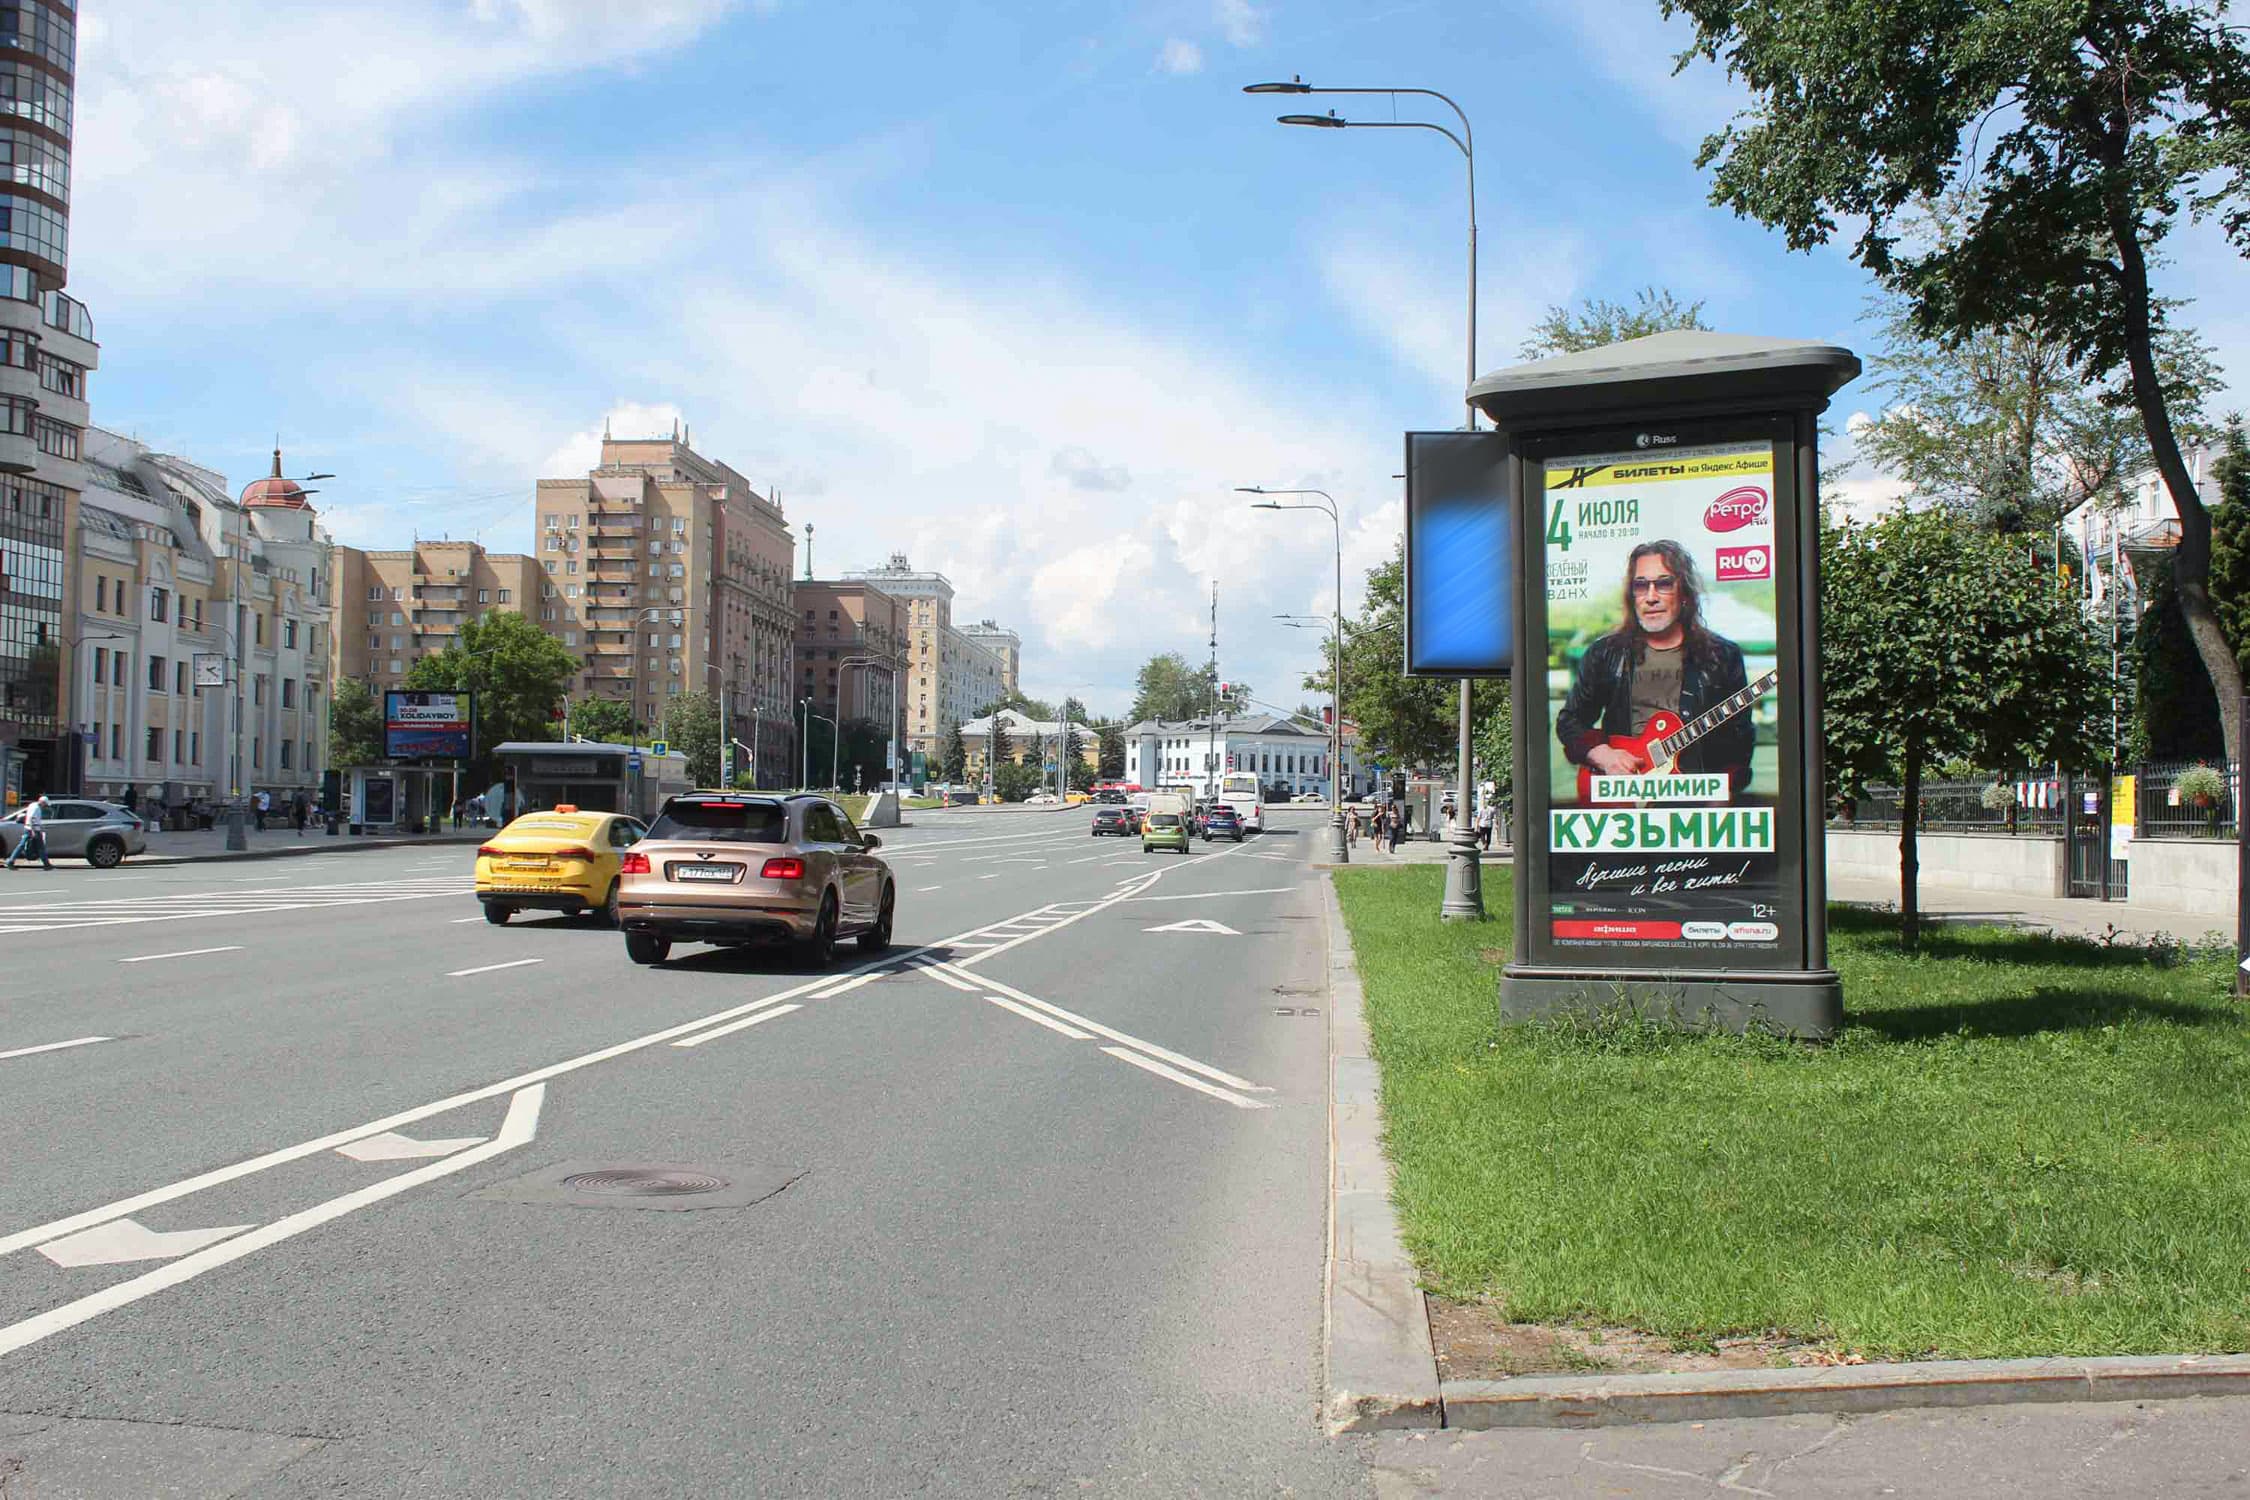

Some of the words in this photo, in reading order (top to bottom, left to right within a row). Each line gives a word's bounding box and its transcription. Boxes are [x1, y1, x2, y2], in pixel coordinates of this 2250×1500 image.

[1653, 435, 1676, 444] Russ
[1613, 465, 1684, 479] БИЛЕТЫ
[1688, 465, 1699, 473] на
[1701, 461, 1734, 473] Яндекс
[1736, 458, 1768, 470] Афише
[1710, 502, 1763, 519] Ретро
[1547, 499, 1572, 552] 4
[1579, 499, 1638, 527] ИЮЛЯ
[1579, 528, 1608, 540] НАЧАЛО
[1610, 528, 1615, 537] В
[1550, 577, 1587, 585] ТЕАТР
[1547, 588, 1588, 600] ВДНХ
[1598, 779, 1721, 799] ВЛАДИМИР
[1553, 812, 1769, 848] КУЗЬМИН
[1576, 862, 1648, 890] Лучшие
[1655, 857, 1708, 874] песни
[1630, 884, 1646, 896] и
[1651, 878, 1678, 894] все
[1684, 860, 1751, 890] хиты!
[1751, 904, 1777, 918] 12+
[1593, 925, 1637, 935] афиша
[1688, 926, 1721, 934] билеты
[1733, 926, 1772, 936] afisha.ru
